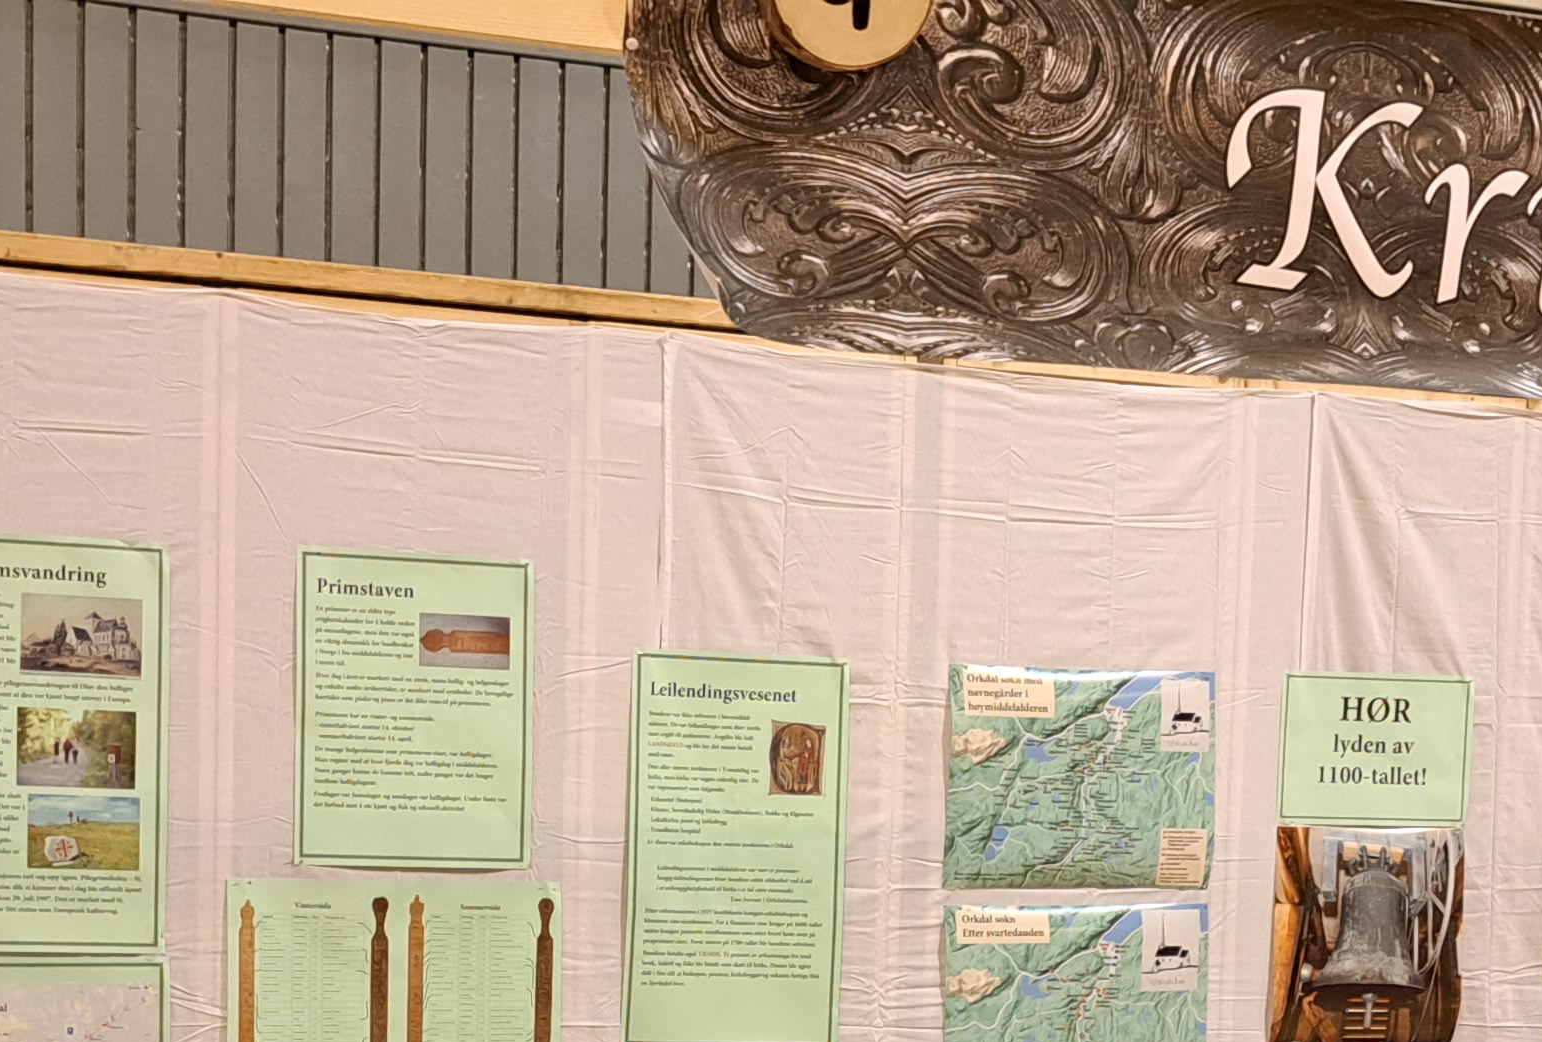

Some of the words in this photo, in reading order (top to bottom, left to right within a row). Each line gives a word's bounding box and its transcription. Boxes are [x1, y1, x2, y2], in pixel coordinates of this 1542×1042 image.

[317, 577, 415, 598] Primstaven
[967, 674, 998, 684] Orkdal
[650, 681, 798, 705] Leilendingsvesenet
[967, 688, 1023, 700] navnegårder
[1339, 695, 1412, 724] HØR
[1333, 734, 1386, 758] lyden
[1392, 741, 1415, 754] av
[1317, 766, 1427, 786] 1100-tallet!
[961, 914, 993, 924] Orkdal
[995, 915, 1016, 924] sokn
